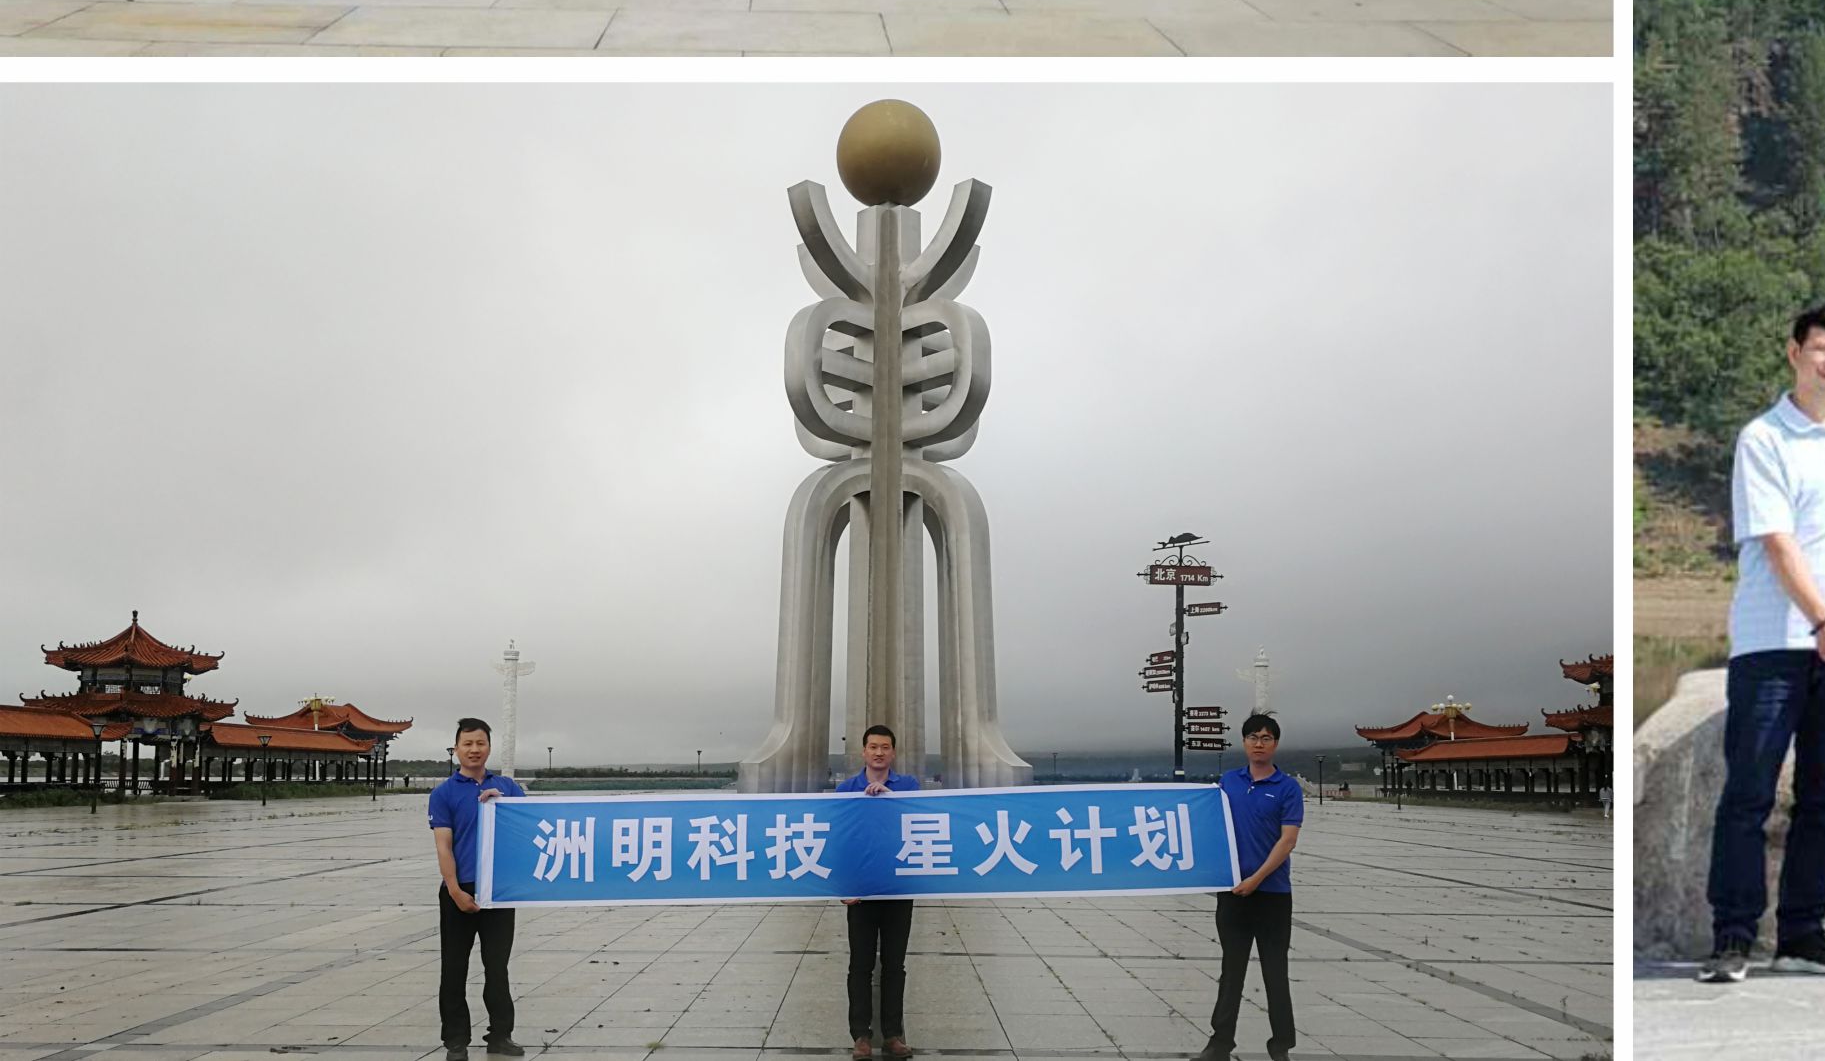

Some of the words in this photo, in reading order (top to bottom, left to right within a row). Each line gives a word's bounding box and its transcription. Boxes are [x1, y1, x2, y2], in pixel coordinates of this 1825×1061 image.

[1154, 568, 1177, 581] 北京
[1180, 574, 1195, 582] 1714
[1197, 574, 1209, 582] Km
[532, 813, 834, 883] 洲明科技
[895, 802, 1196, 877] 星火计划
